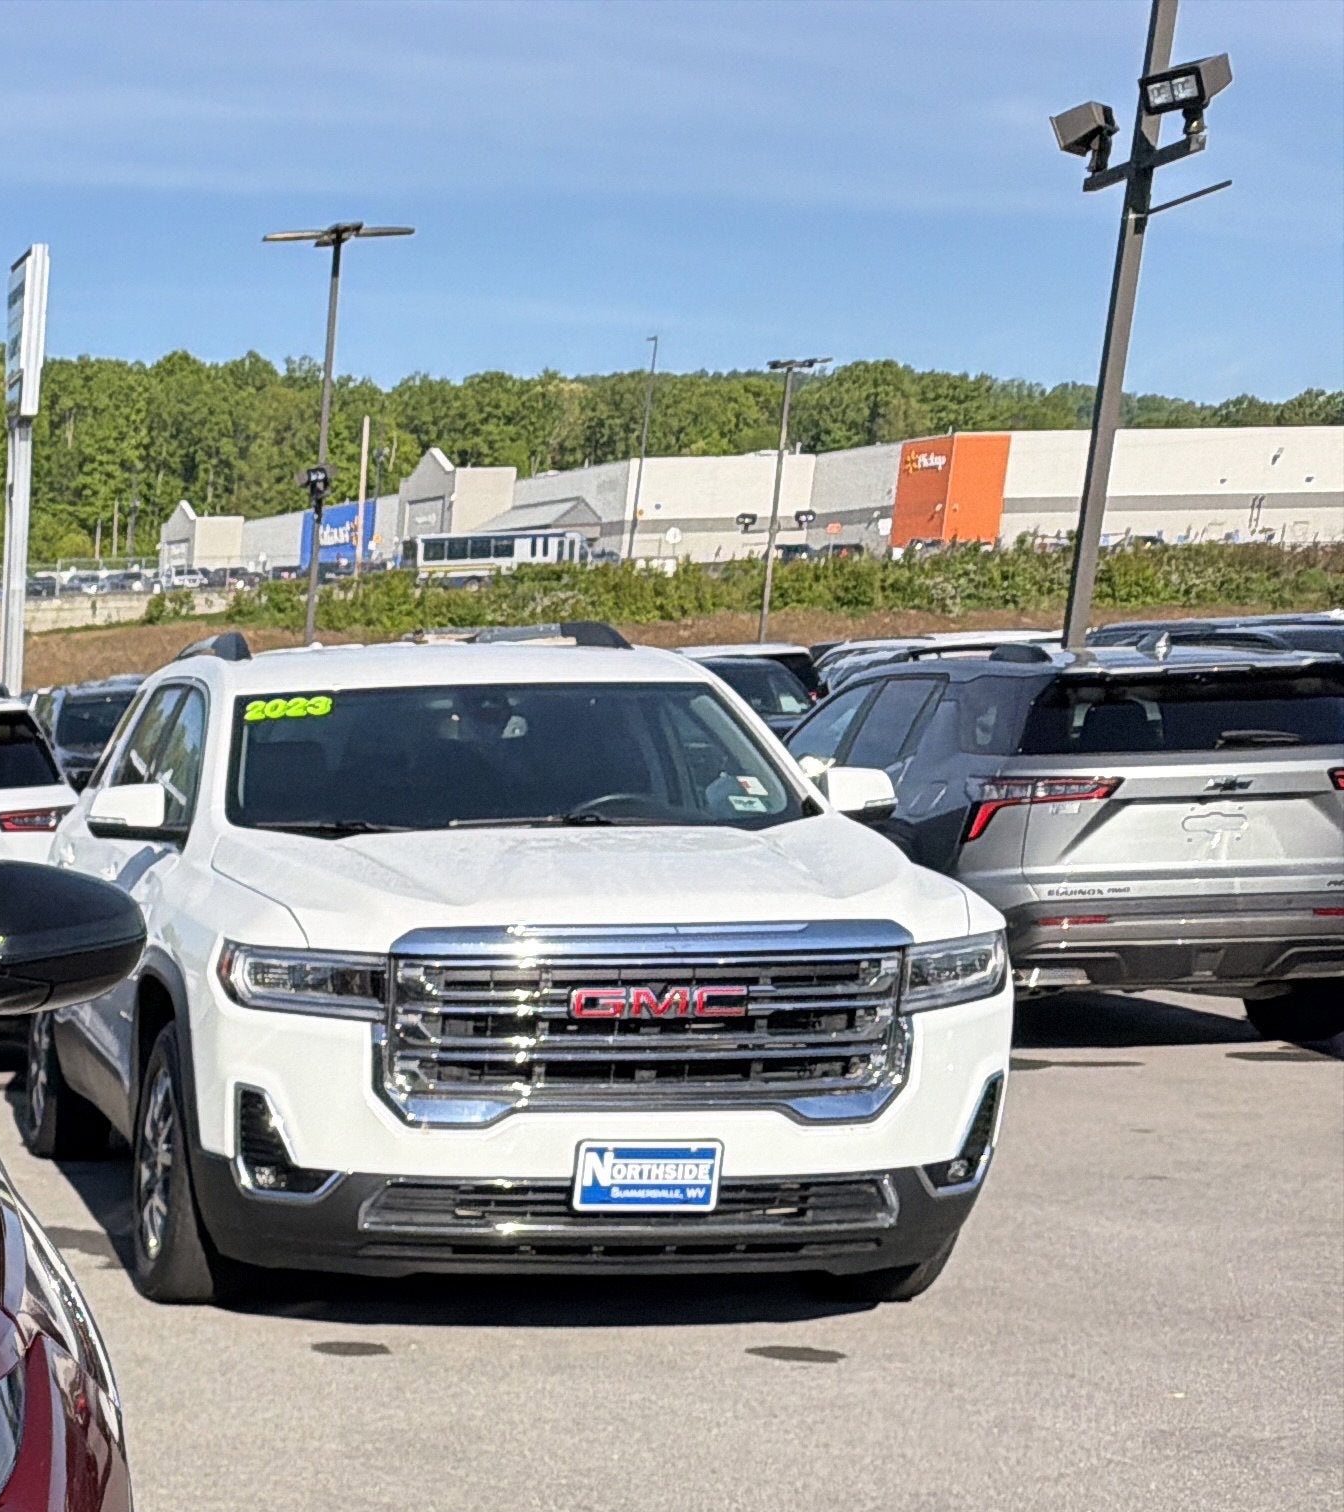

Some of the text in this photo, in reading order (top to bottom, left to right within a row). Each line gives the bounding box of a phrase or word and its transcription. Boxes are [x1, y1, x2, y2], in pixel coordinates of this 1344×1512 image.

[244, 696, 333, 720] 2023
[570, 985, 748, 1019] GMC
[583, 1151, 711, 1187] NORTHSIDE
[686, 1187, 706, 1199] WV
